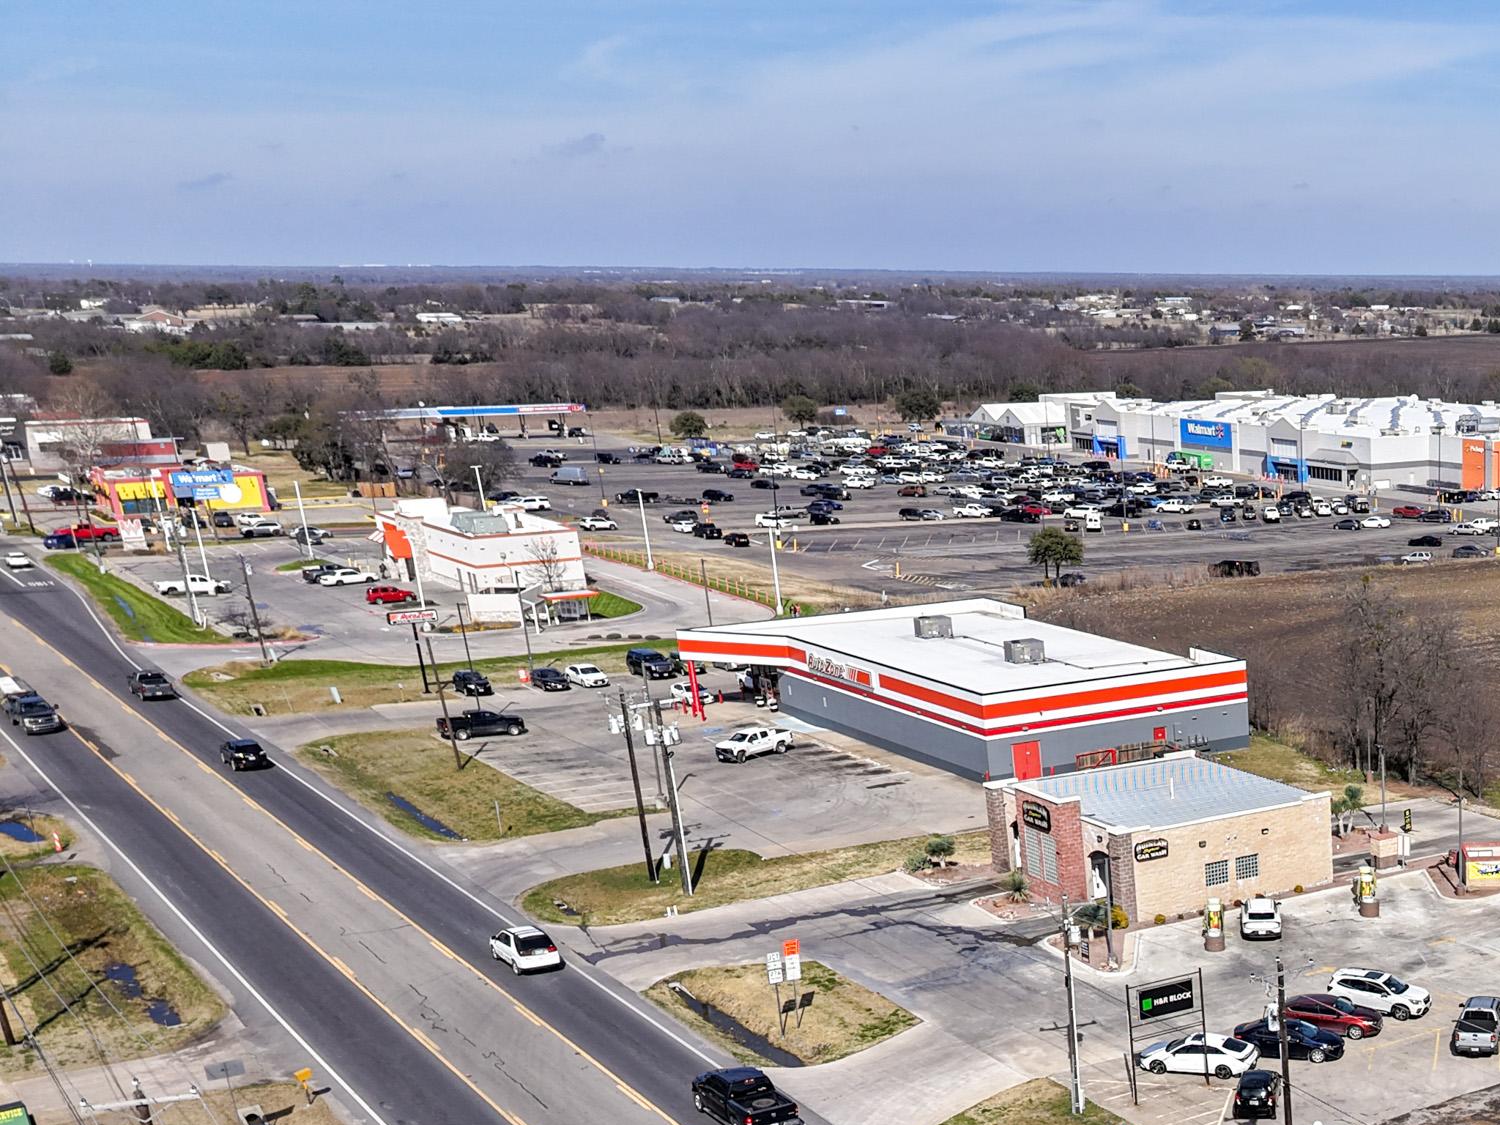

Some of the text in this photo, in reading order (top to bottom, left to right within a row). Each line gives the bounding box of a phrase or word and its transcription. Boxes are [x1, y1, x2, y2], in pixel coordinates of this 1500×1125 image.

[1187, 422, 1217, 436] Walmart
[808, 653, 846, 679] AutoZone
[1153, 991, 1192, 1006] H&R BLOCK
